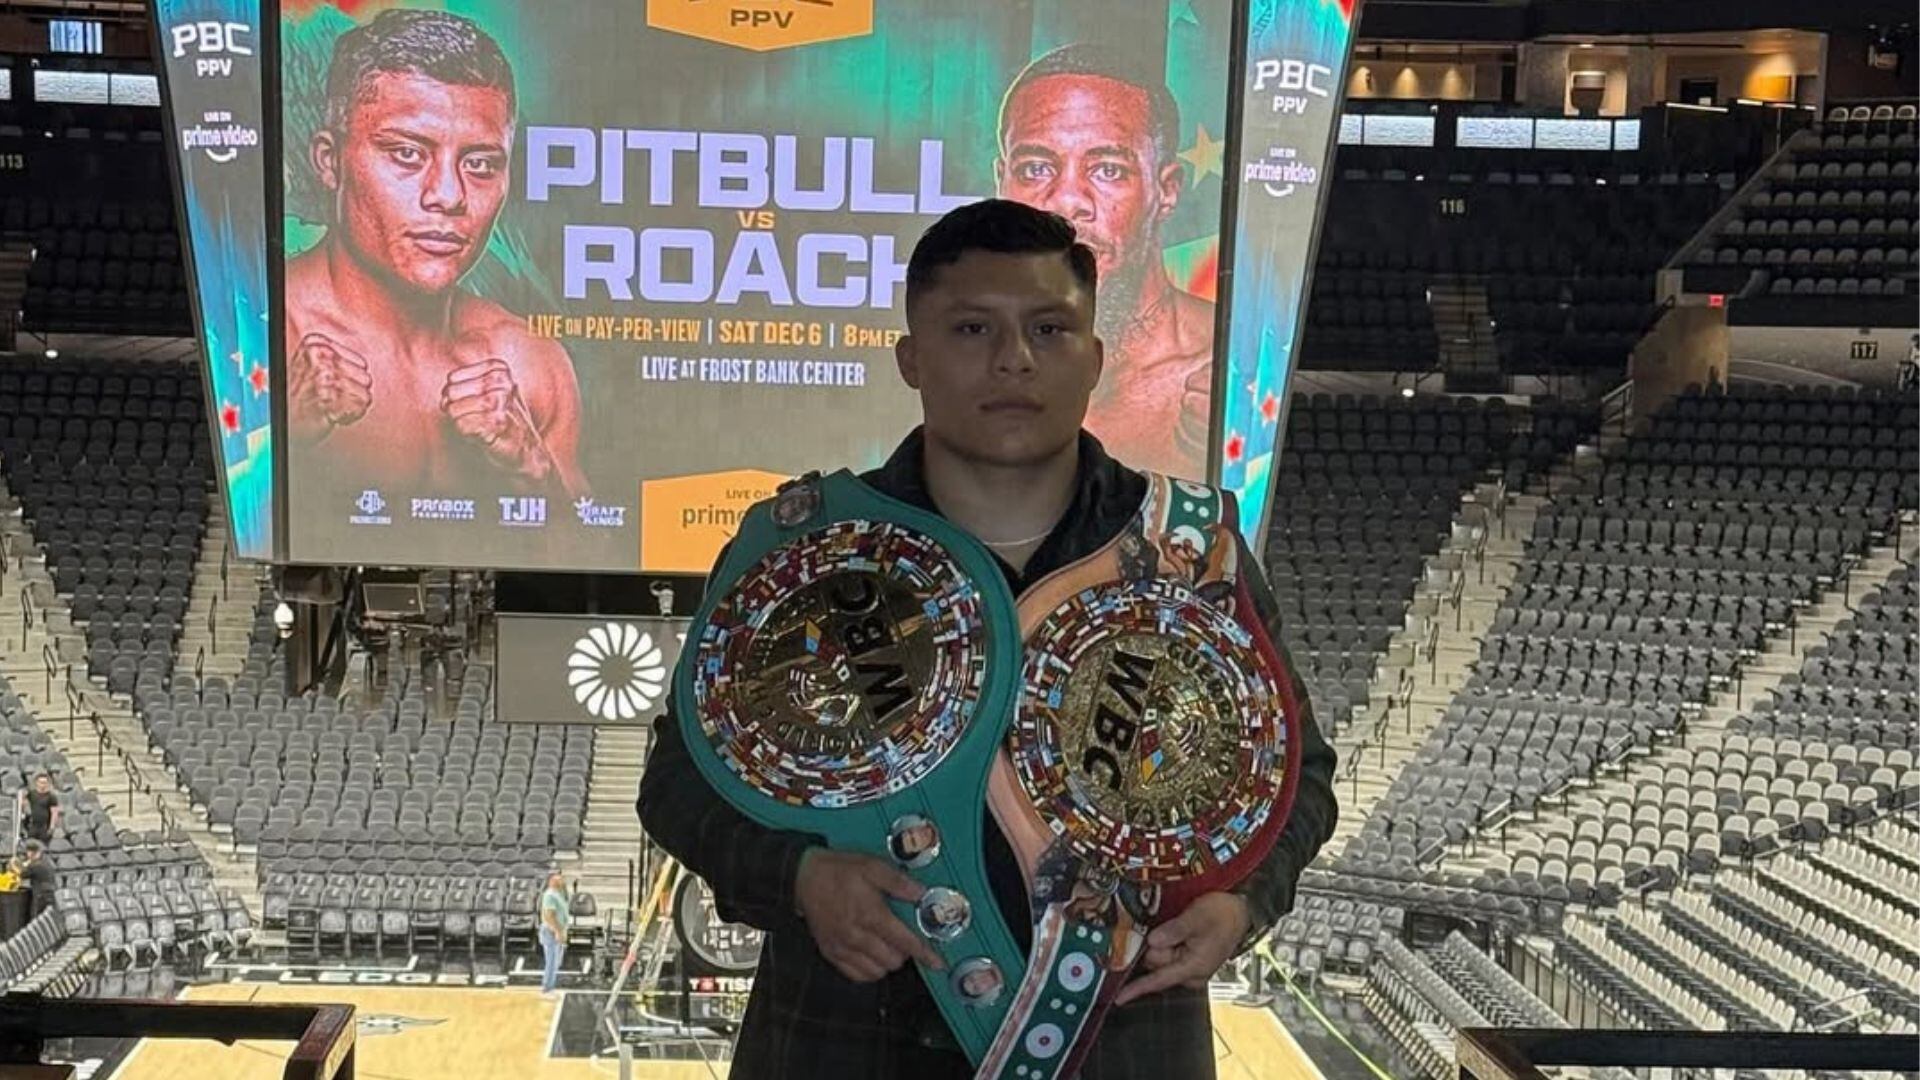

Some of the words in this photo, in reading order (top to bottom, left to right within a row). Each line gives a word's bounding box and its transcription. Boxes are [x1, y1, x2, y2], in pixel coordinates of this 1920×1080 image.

[729, 9, 794, 29] PPV
[171, 21, 252, 58] PBC
[196, 58, 232, 76] PPV
[1253, 59, 1331, 97] PBC
[1273, 95, 1308, 114] PPV
[182, 124, 220, 150] prime
[220, 124, 258, 146] video
[0, 153, 24, 169] 113
[526, 126, 985, 214] PITBULL
[1244, 159, 1283, 183] prime
[1283, 161, 1317, 183] video
[737, 210, 776, 230] VS
[528, 314, 563, 338] LIVE
[565, 318, 582, 336] ON
[586, 316, 701, 343] PAY-PER-VIEW
[719, 320, 759, 344] SAT
[763, 321, 804, 346] DEC
[807, 322, 822, 346] 6
[1854, 343, 1876, 359] 117
[641, 355, 678, 380] LIVE
[680, 360, 698, 378] AT
[700, 357, 752, 383] FROST
[755, 359, 800, 384] BANK
[802, 361, 865, 387] CENTER
[726, 488, 750, 500] LIVE
[499, 497, 546, 521] TJH
[581, 505, 626, 519] DRAFT
[831, 571, 917, 724] WBC
[1083, 650, 1155, 791] WBC
[278, 969, 508, 985] LEDGER
